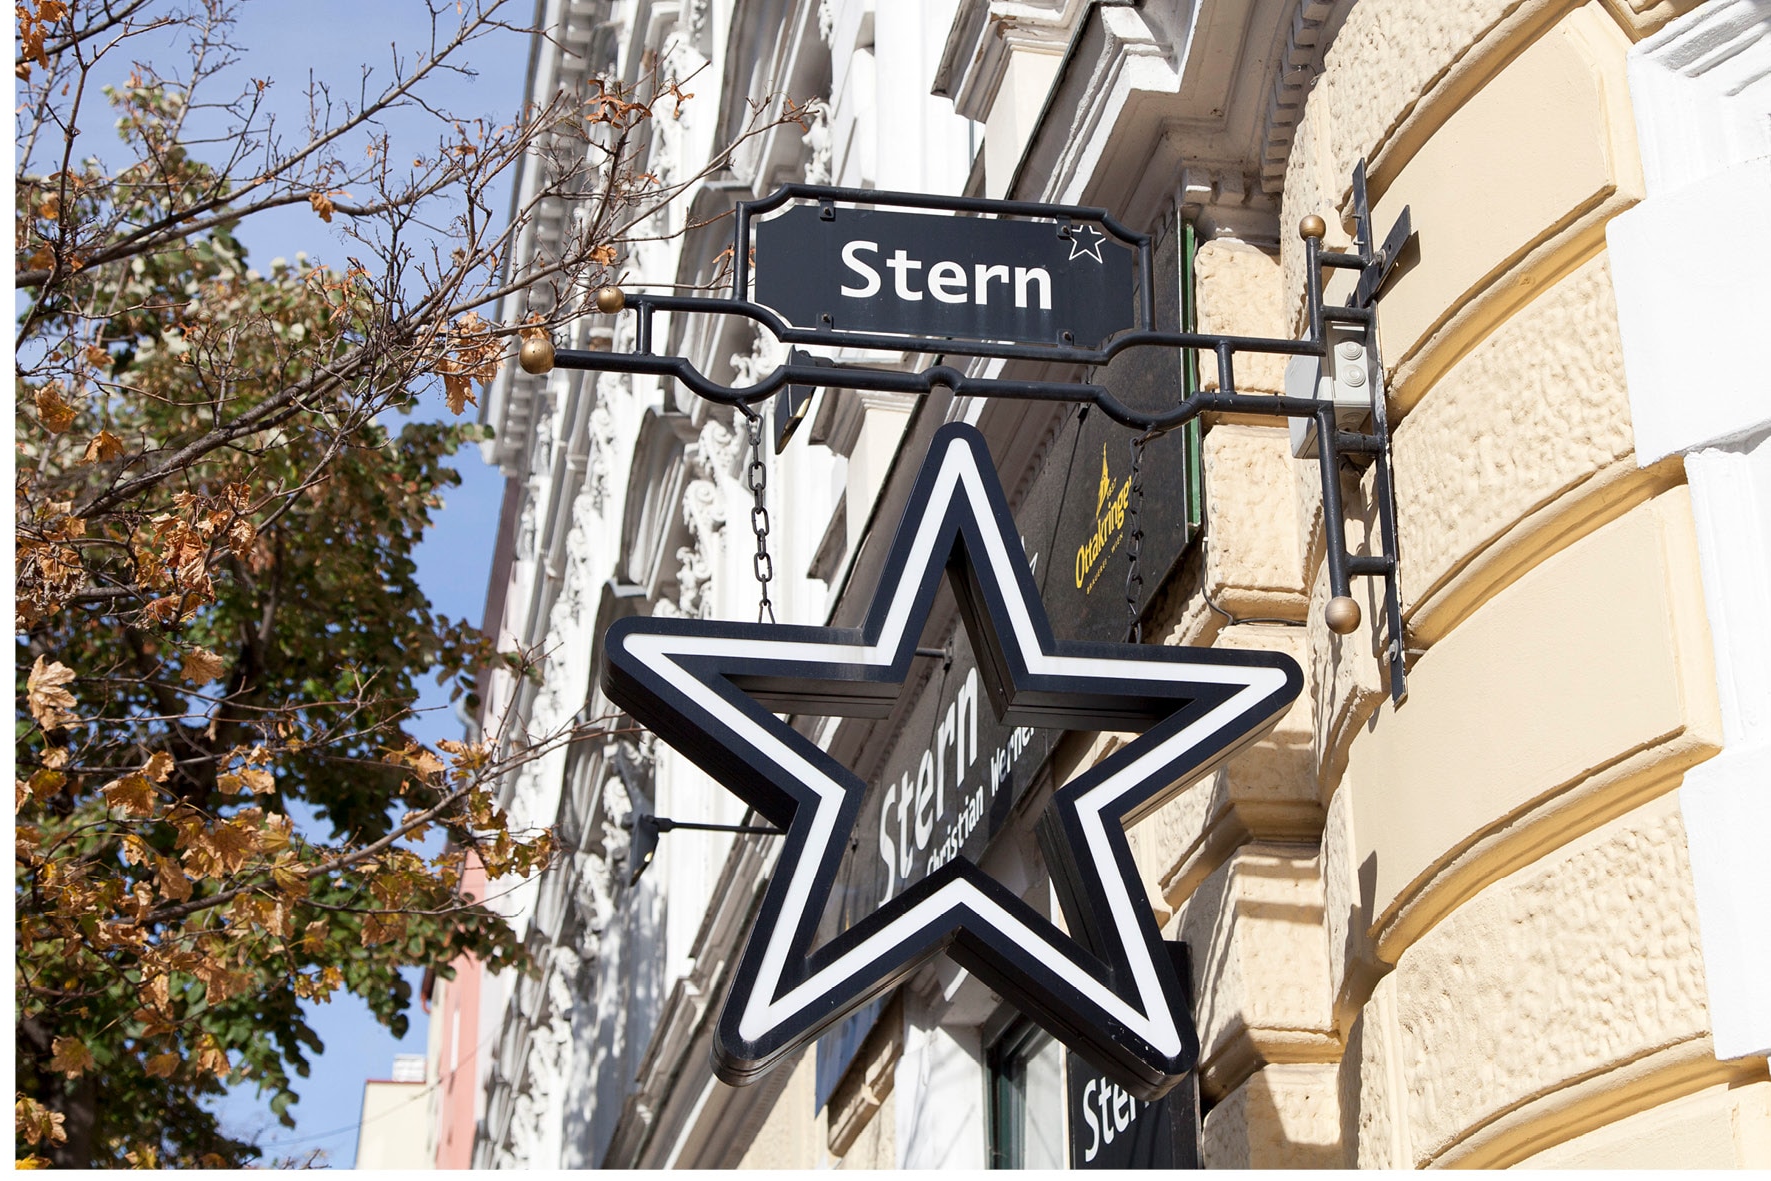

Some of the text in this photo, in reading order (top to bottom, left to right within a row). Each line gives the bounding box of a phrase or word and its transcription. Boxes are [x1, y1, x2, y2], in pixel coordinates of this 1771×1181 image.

[840, 240, 1053, 310] Stern
[879, 667, 978, 908] Stern
[926, 785, 984, 877] Christian
[1083, 1077, 1150, 1162] Ste
